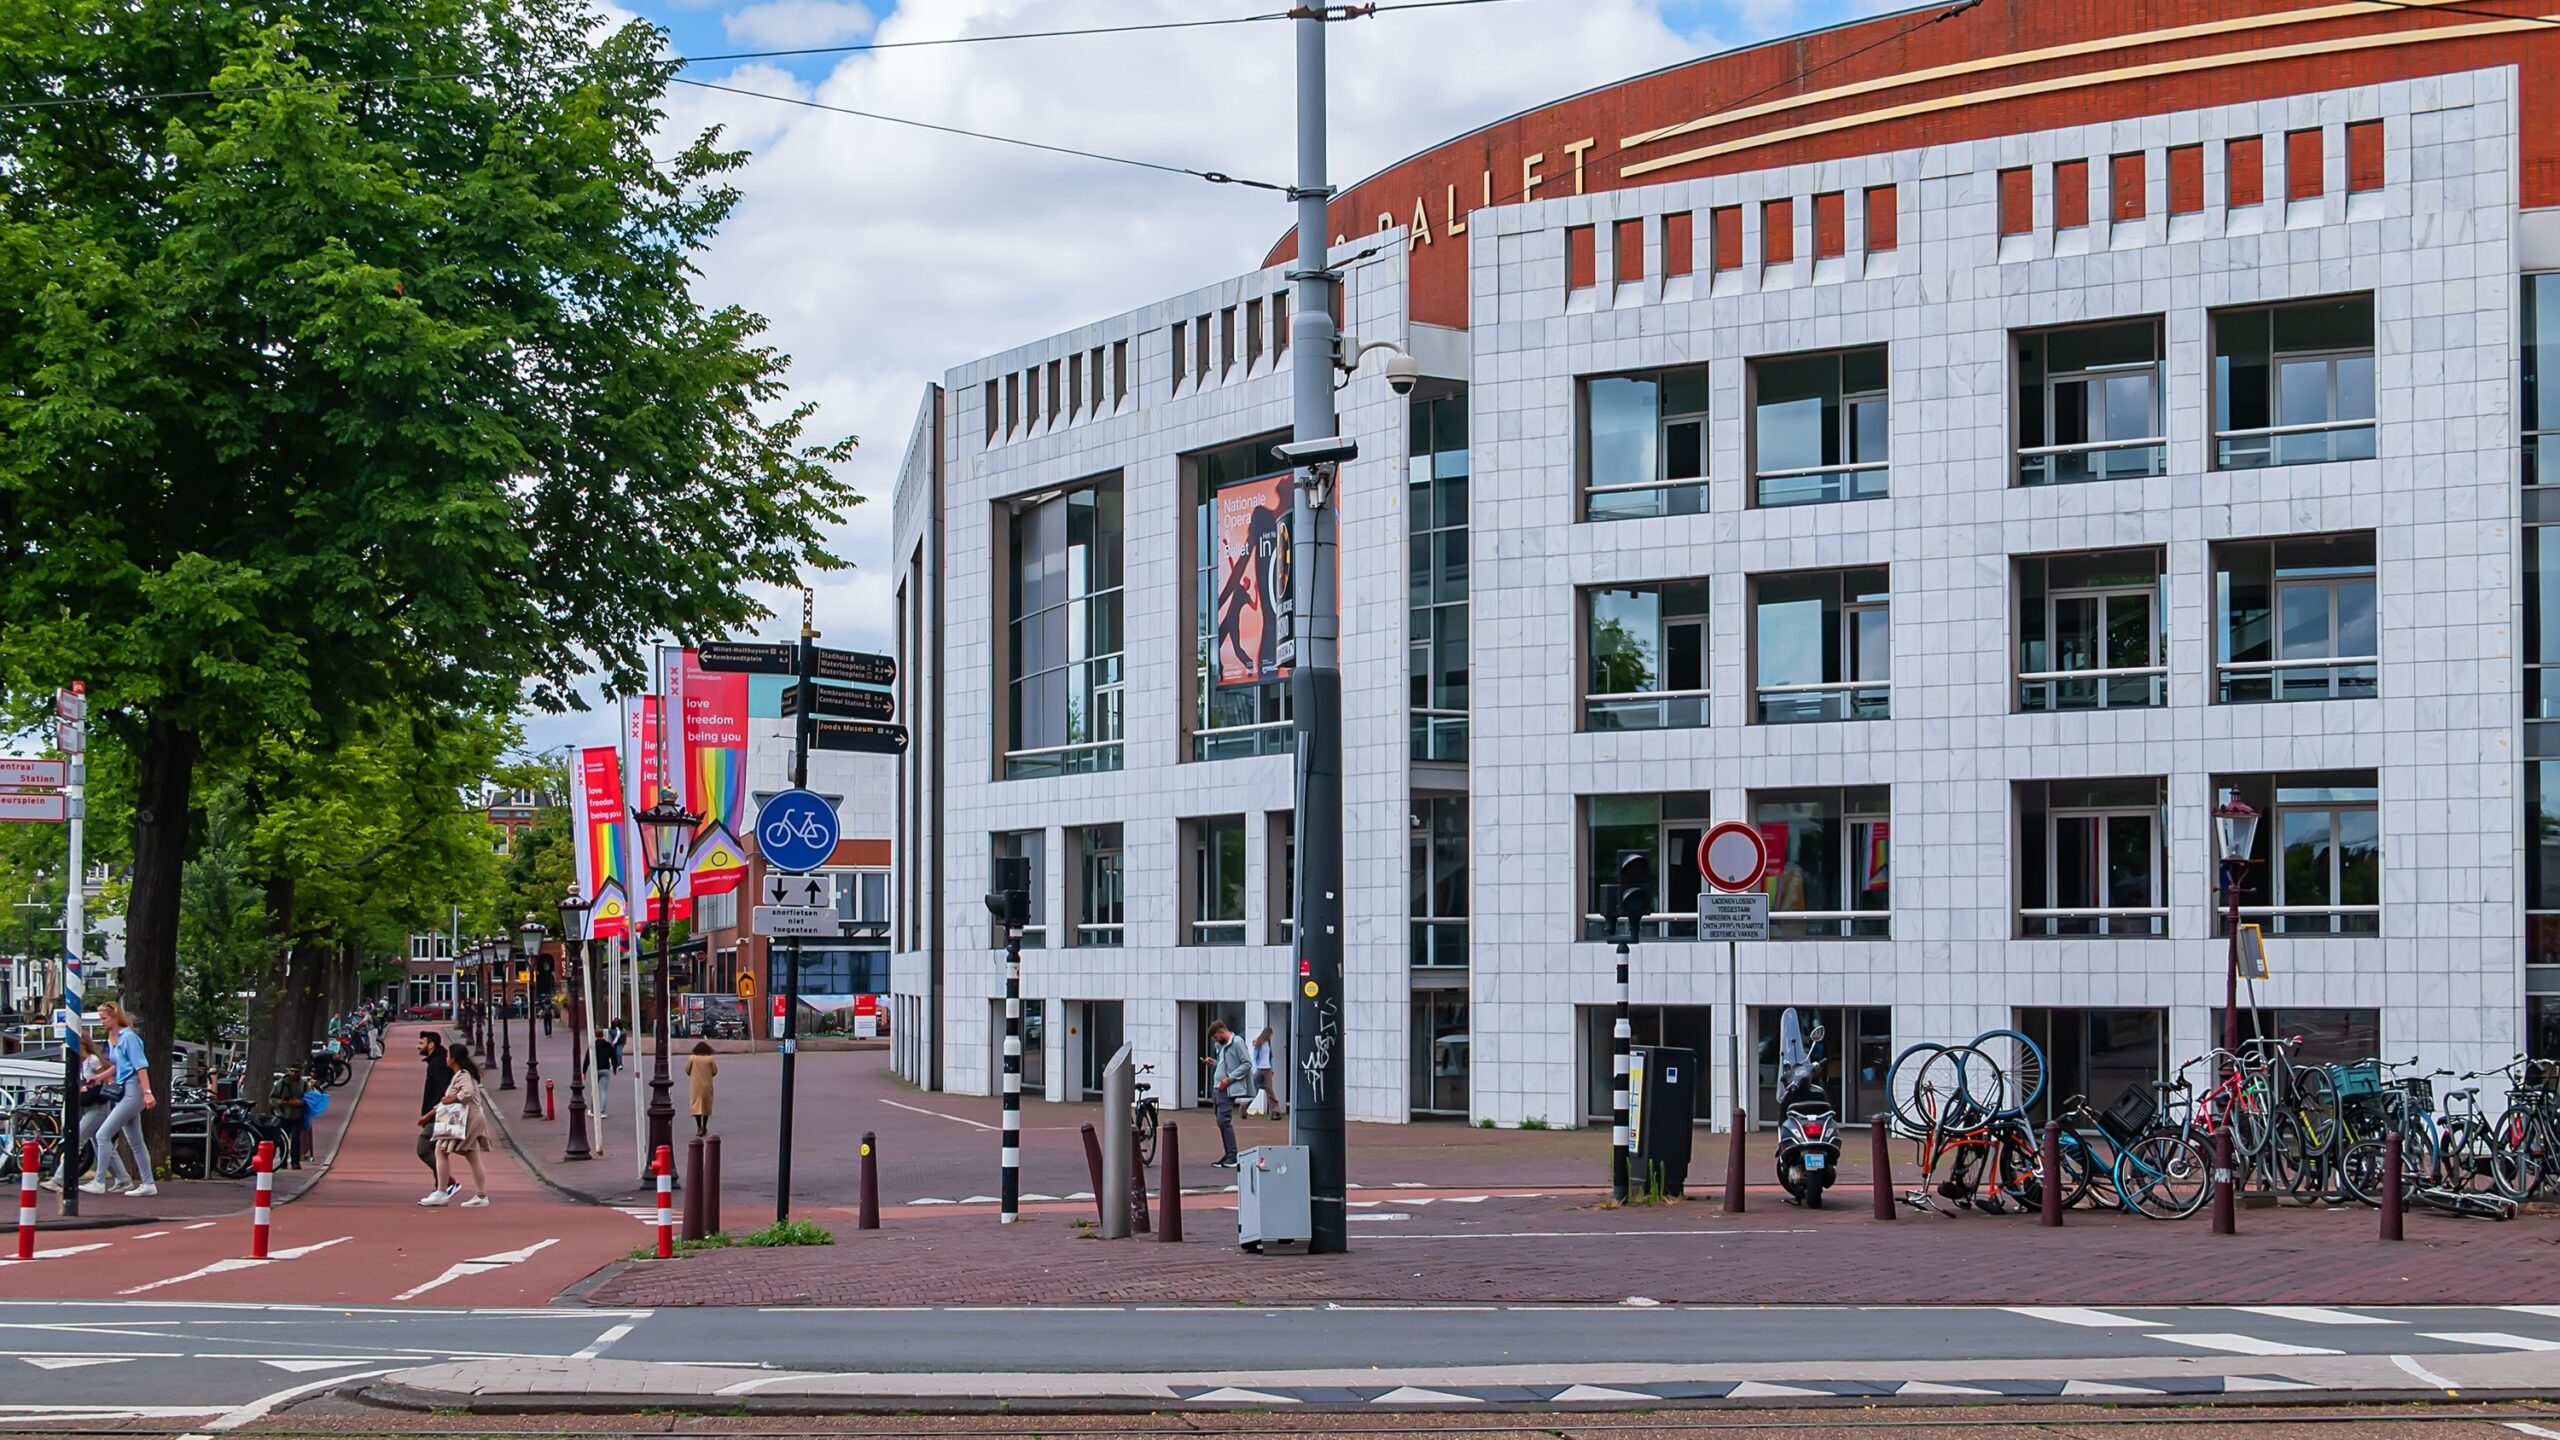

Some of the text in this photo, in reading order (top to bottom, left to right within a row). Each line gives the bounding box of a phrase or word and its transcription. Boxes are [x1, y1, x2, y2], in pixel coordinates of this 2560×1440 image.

[1224, 493, 1266, 513] Nationale
[1224, 513, 1252, 529] Opera
[1224, 542, 1249, 558] Ballet
[1259, 537, 1271, 558] In
[712, 654, 763, 662] Rembrandtplein
[821, 652, 849, 661] Stadhuis
[821, 660, 866, 671] Waterlooplein
[820, 668, 865, 679] Waterlooplein
[687, 698, 710, 708] love
[819, 696, 844, 704] Centraal
[844, 699, 865, 707] Station
[687, 714, 734, 725] freedom
[820, 722, 841, 731] Joods
[688, 731, 742, 743] being you
[0, 763, 35, 771] entraal
[20, 775, 55, 783] Station
[588, 787, 603, 795] love
[0, 797, 46, 805] eursplein
[590, 811, 610, 820] being
[773, 926, 818, 934] toegestaan
